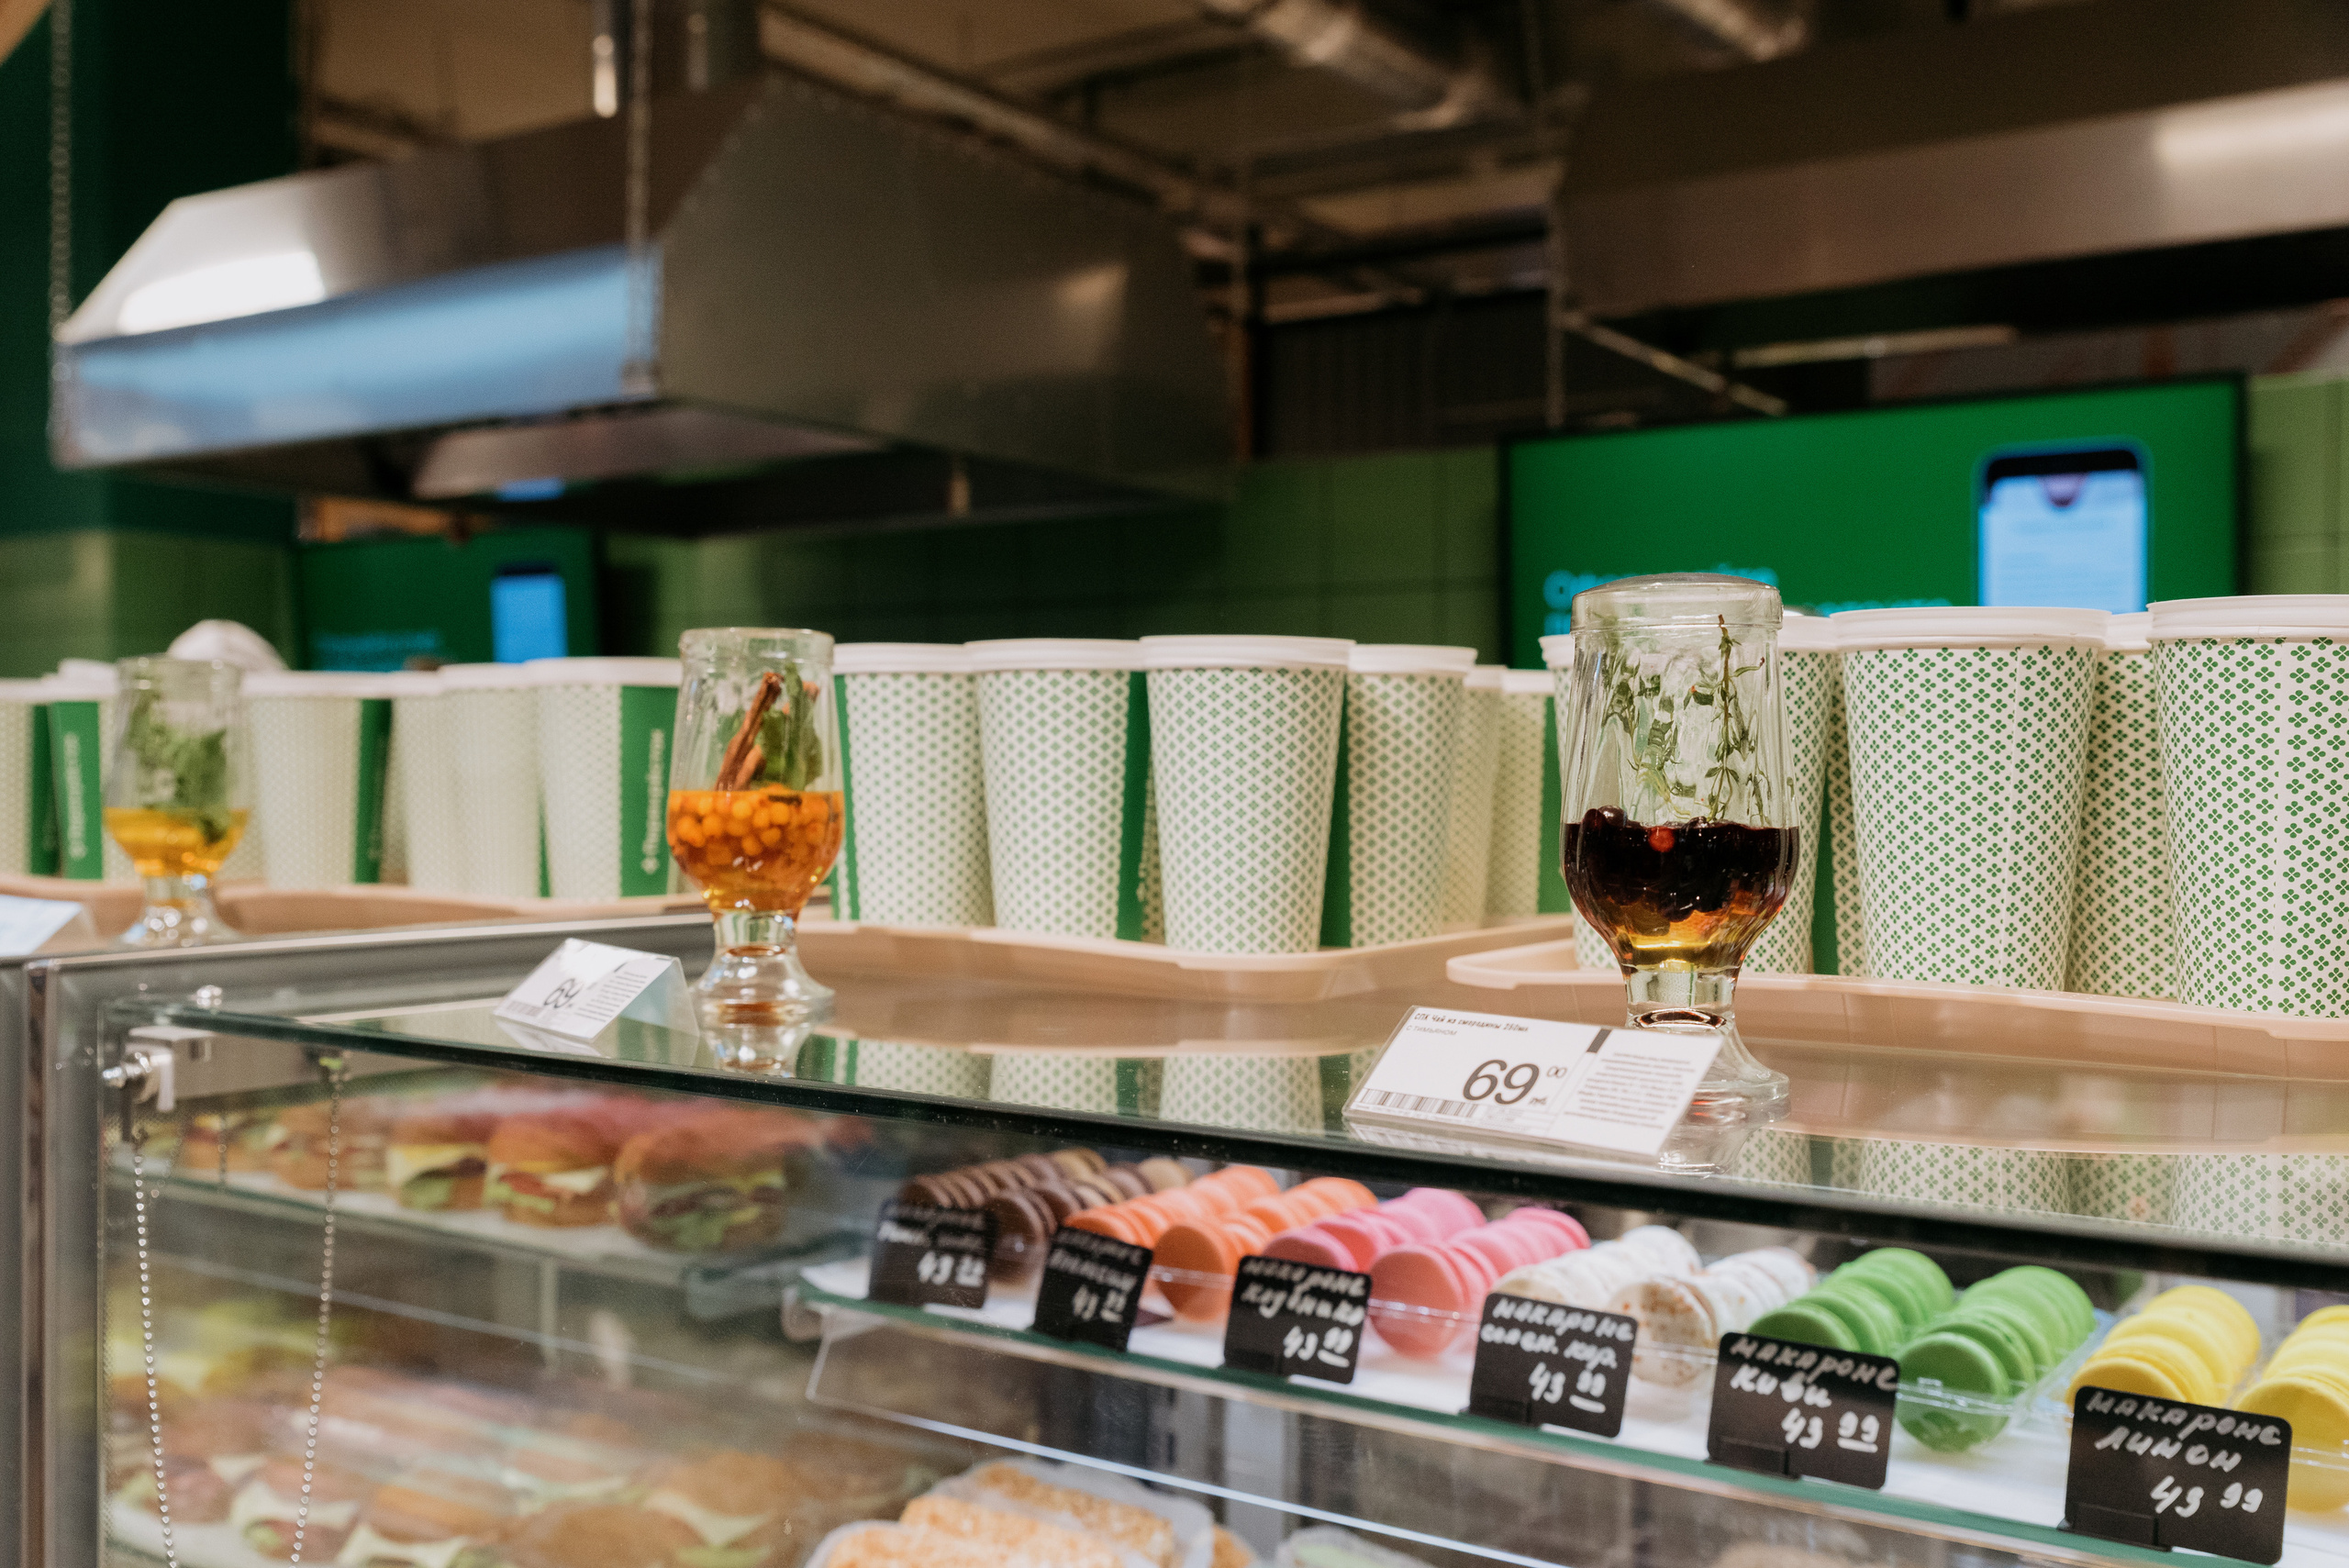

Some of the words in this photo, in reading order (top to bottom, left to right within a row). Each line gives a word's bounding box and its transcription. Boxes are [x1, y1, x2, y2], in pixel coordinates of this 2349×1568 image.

[1431, 1015, 1444, 1023] Чай
[1463, 1059, 1541, 1105] 69
[1546, 1066, 1567, 1078] 00
[1838, 1410, 1880, 1444] 99
[2094, 1425, 2243, 1473] ЛИМОН
[2219, 1481, 2264, 1514] 99
